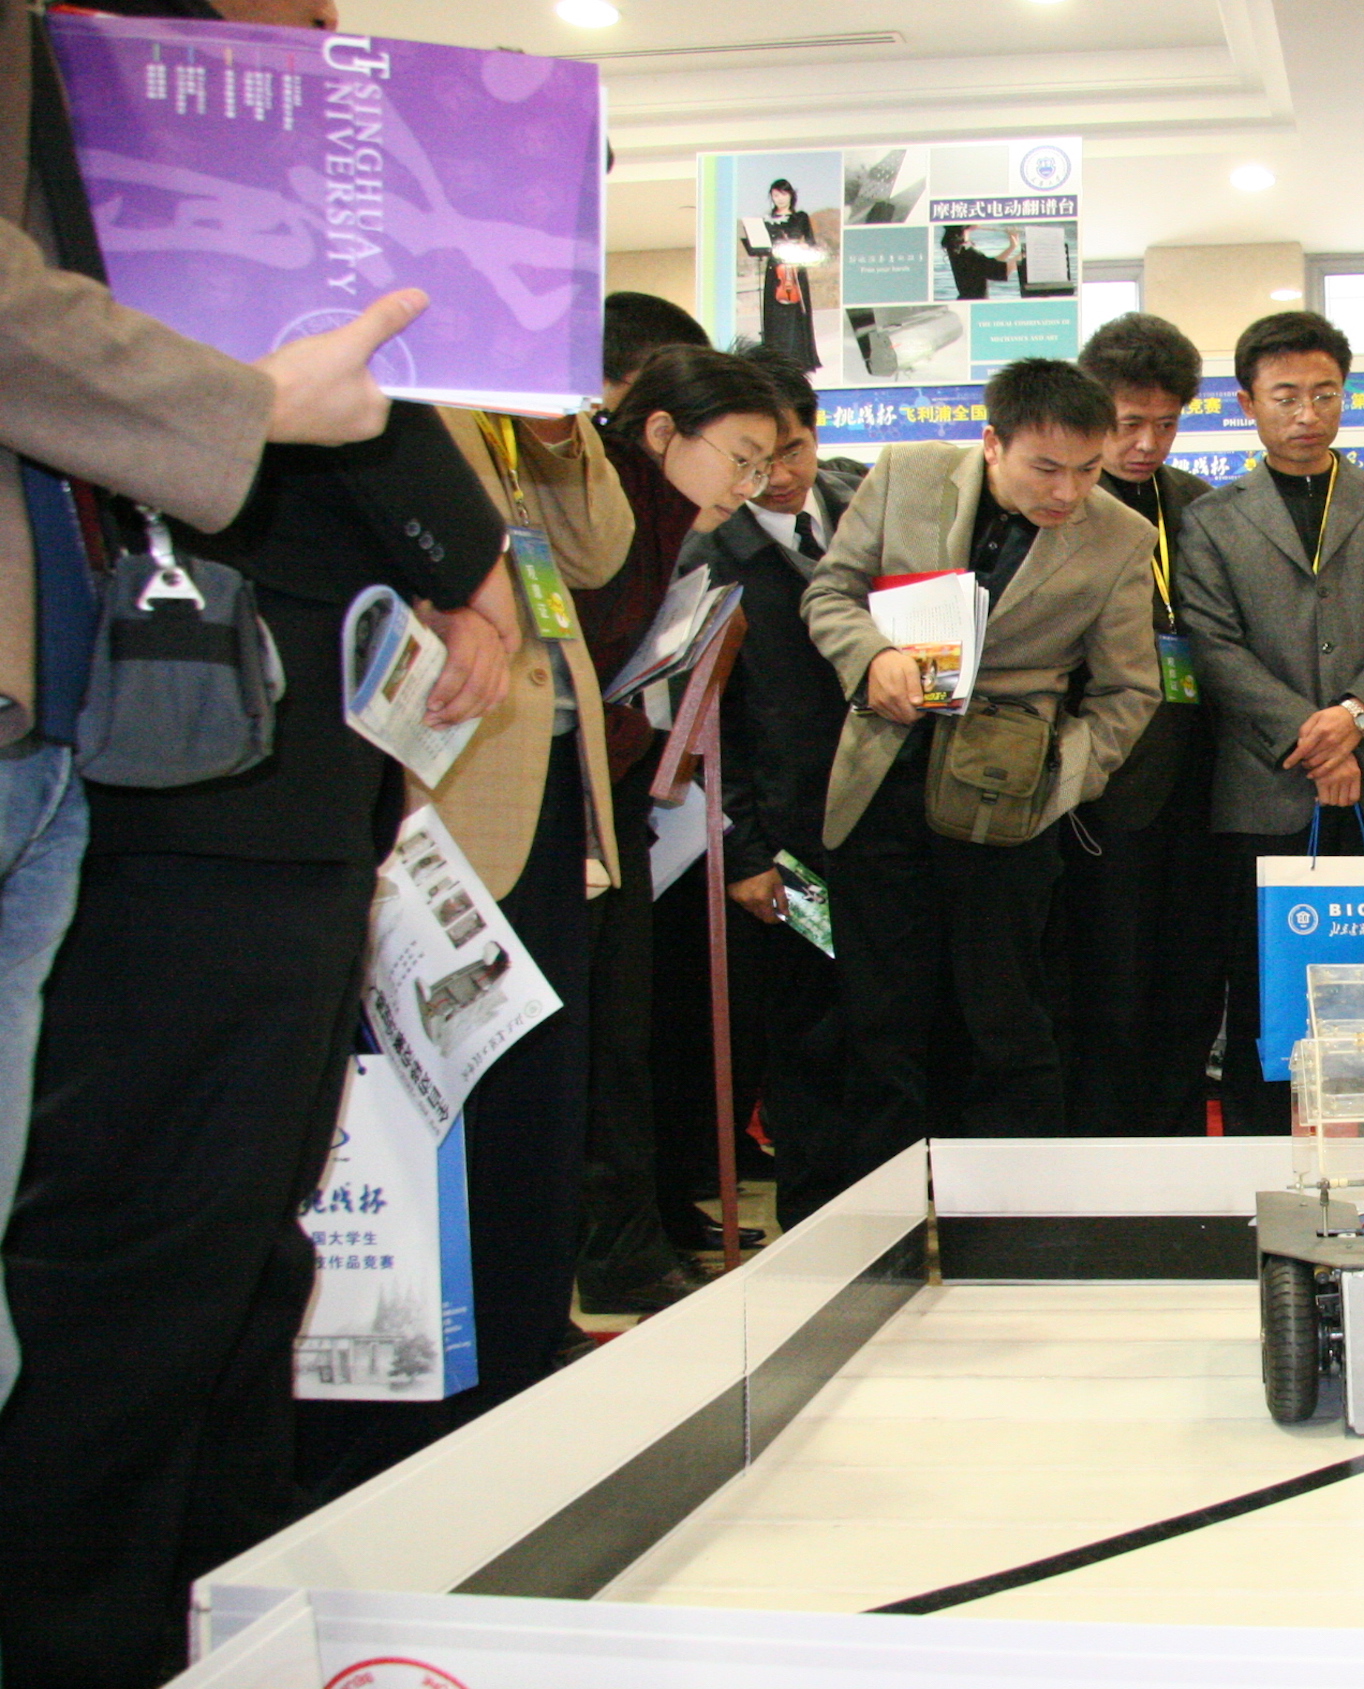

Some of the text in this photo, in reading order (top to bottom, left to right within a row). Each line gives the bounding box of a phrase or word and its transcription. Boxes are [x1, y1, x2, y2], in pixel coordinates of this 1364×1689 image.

[323, 37, 371, 296] UNIVERSITY
[352, 50, 391, 260] TSINGHUA
[932, 198, 1074, 219] 摩擦式电动翻谱台
[312, 1231, 378, 1246] 国大学生
